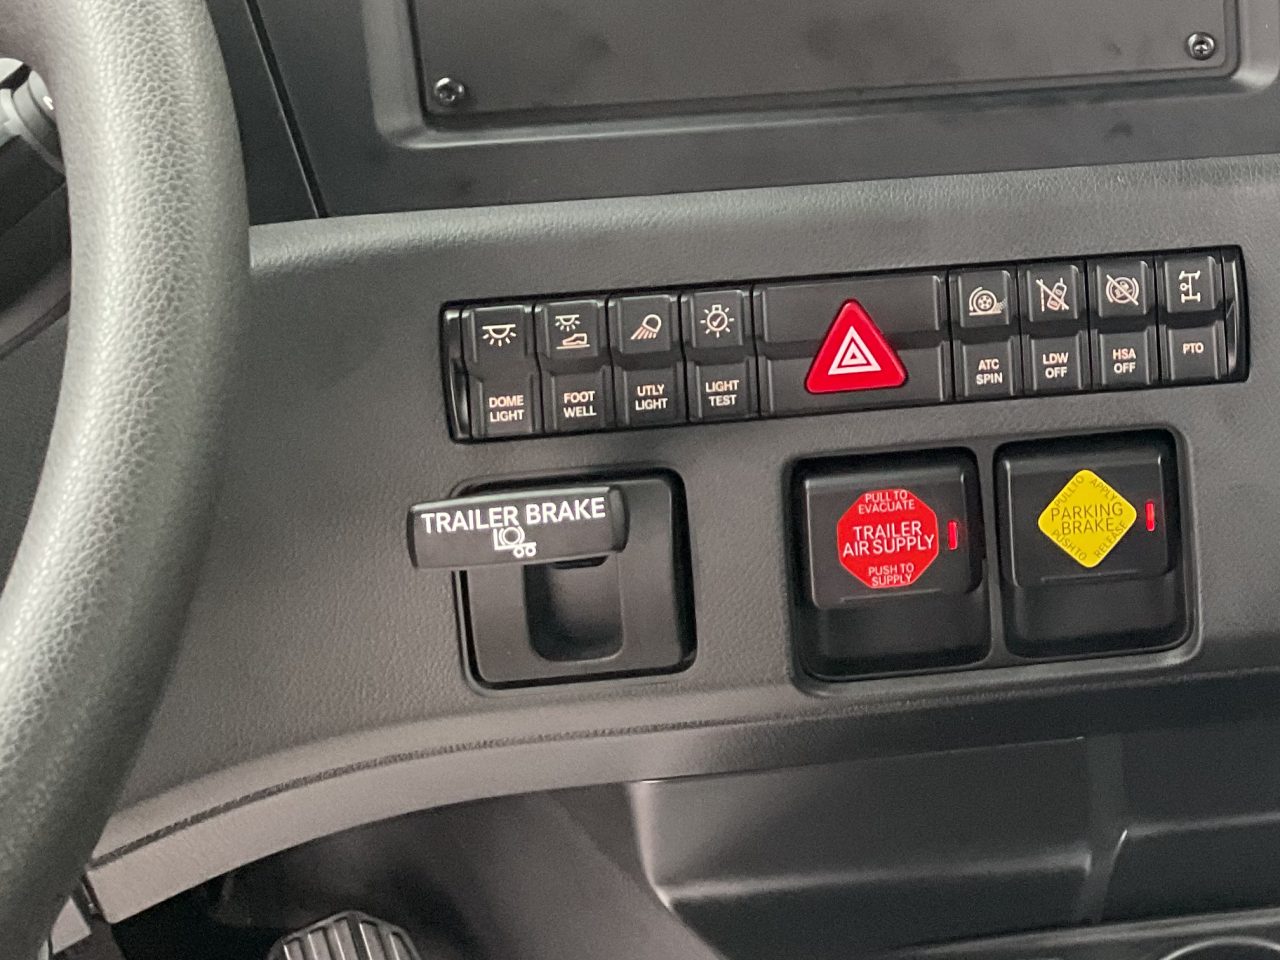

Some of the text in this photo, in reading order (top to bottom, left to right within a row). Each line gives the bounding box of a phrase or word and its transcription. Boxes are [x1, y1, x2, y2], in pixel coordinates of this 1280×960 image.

[1112, 348, 1137, 360] HSA
[1182, 342, 1205, 355] PTO
[978, 358, 1000, 371] ATC
[1042, 351, 1069, 365] LDW
[1045, 366, 1068, 379] OFF
[1113, 361, 1136, 374] OFF
[976, 372, 1003, 385] SPIN
[636, 383, 665, 397] UTLY
[705, 379, 740, 394] LIGHT
[488, 394, 524, 408] DOME
[563, 390, 596, 404] FOOT
[635, 397, 668, 411] LIGHT
[708, 394, 737, 407] TEST
[489, 408, 524, 423] LIGHT
[563, 404, 597, 418] WELL
[865, 489, 908, 503] PULL TO
[1053, 484, 1076, 508] PULL
[1090, 477, 1118, 502] APPLY
[858, 499, 916, 515] EVACUATE
[1051, 501, 1124, 522] PARKING
[421, 496, 606, 534] TRAILER BRAKE
[853, 520, 922, 541] TRAILER
[1061, 517, 1116, 535] BRAKE
[842, 533, 935, 558] AIR SUPPLY
[1051, 529, 1077, 552] PUSH
[1094, 520, 1127, 559] RELEASE
[868, 562, 914, 577] PUSH TO
[871, 573, 913, 587] SUPPLY
